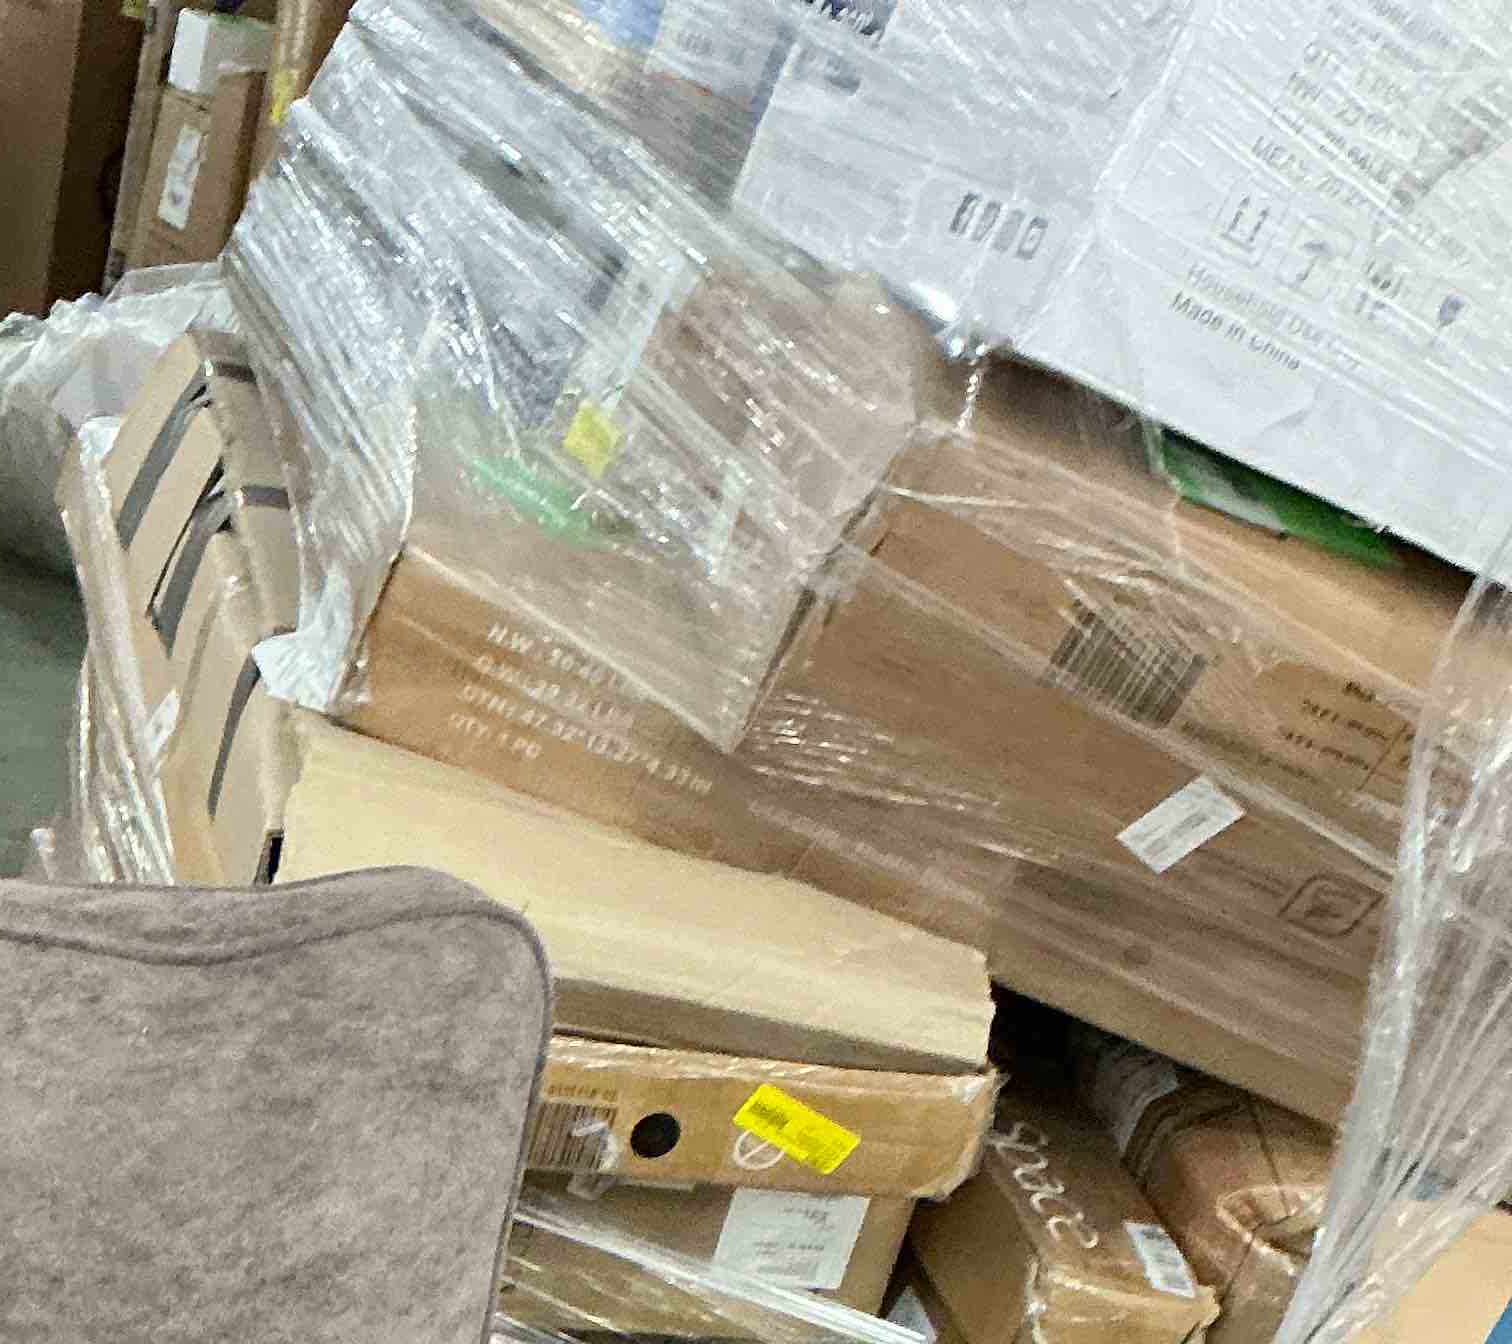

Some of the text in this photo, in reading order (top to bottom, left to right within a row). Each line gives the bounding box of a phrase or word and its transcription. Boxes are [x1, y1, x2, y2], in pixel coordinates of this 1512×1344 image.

[1169, 291, 1301, 371] Made in China
